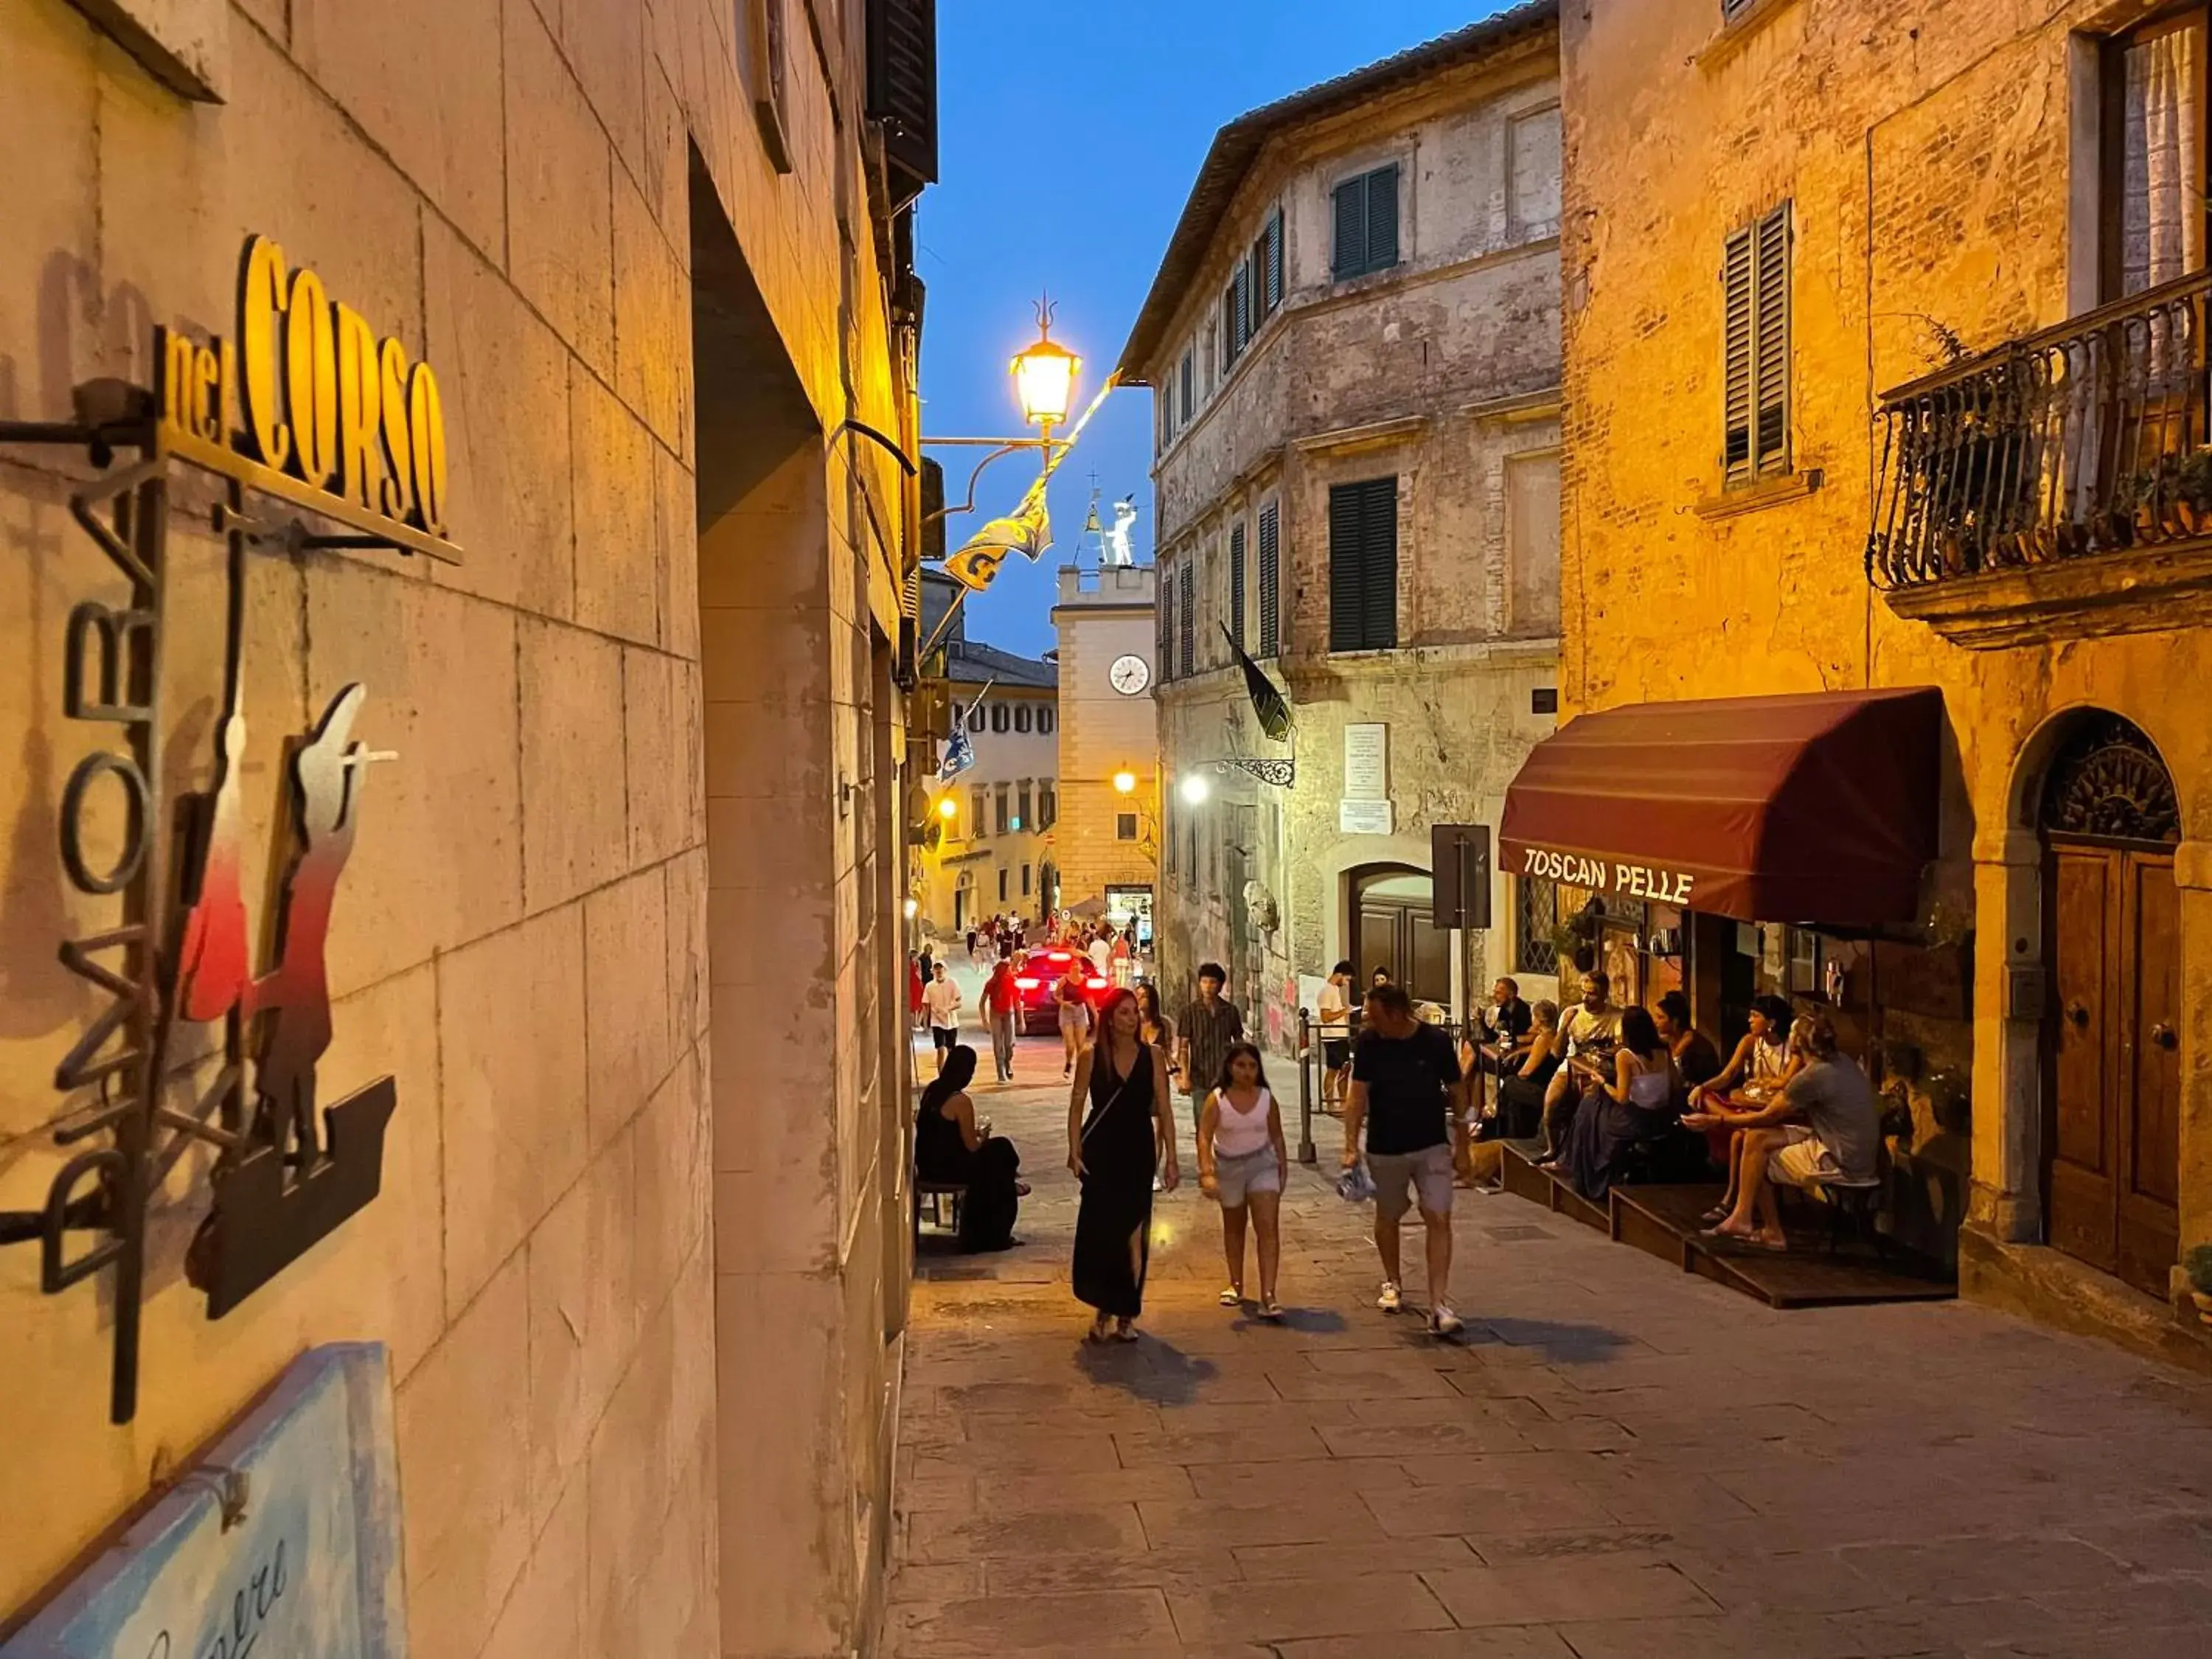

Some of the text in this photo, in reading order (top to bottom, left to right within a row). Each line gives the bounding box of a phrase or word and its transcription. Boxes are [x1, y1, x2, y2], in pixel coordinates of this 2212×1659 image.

[155, 233, 447, 537] nel CORSO
[42, 459, 164, 1294] DIMORA
[1523, 849, 1694, 905] TOSCAN PELLE
